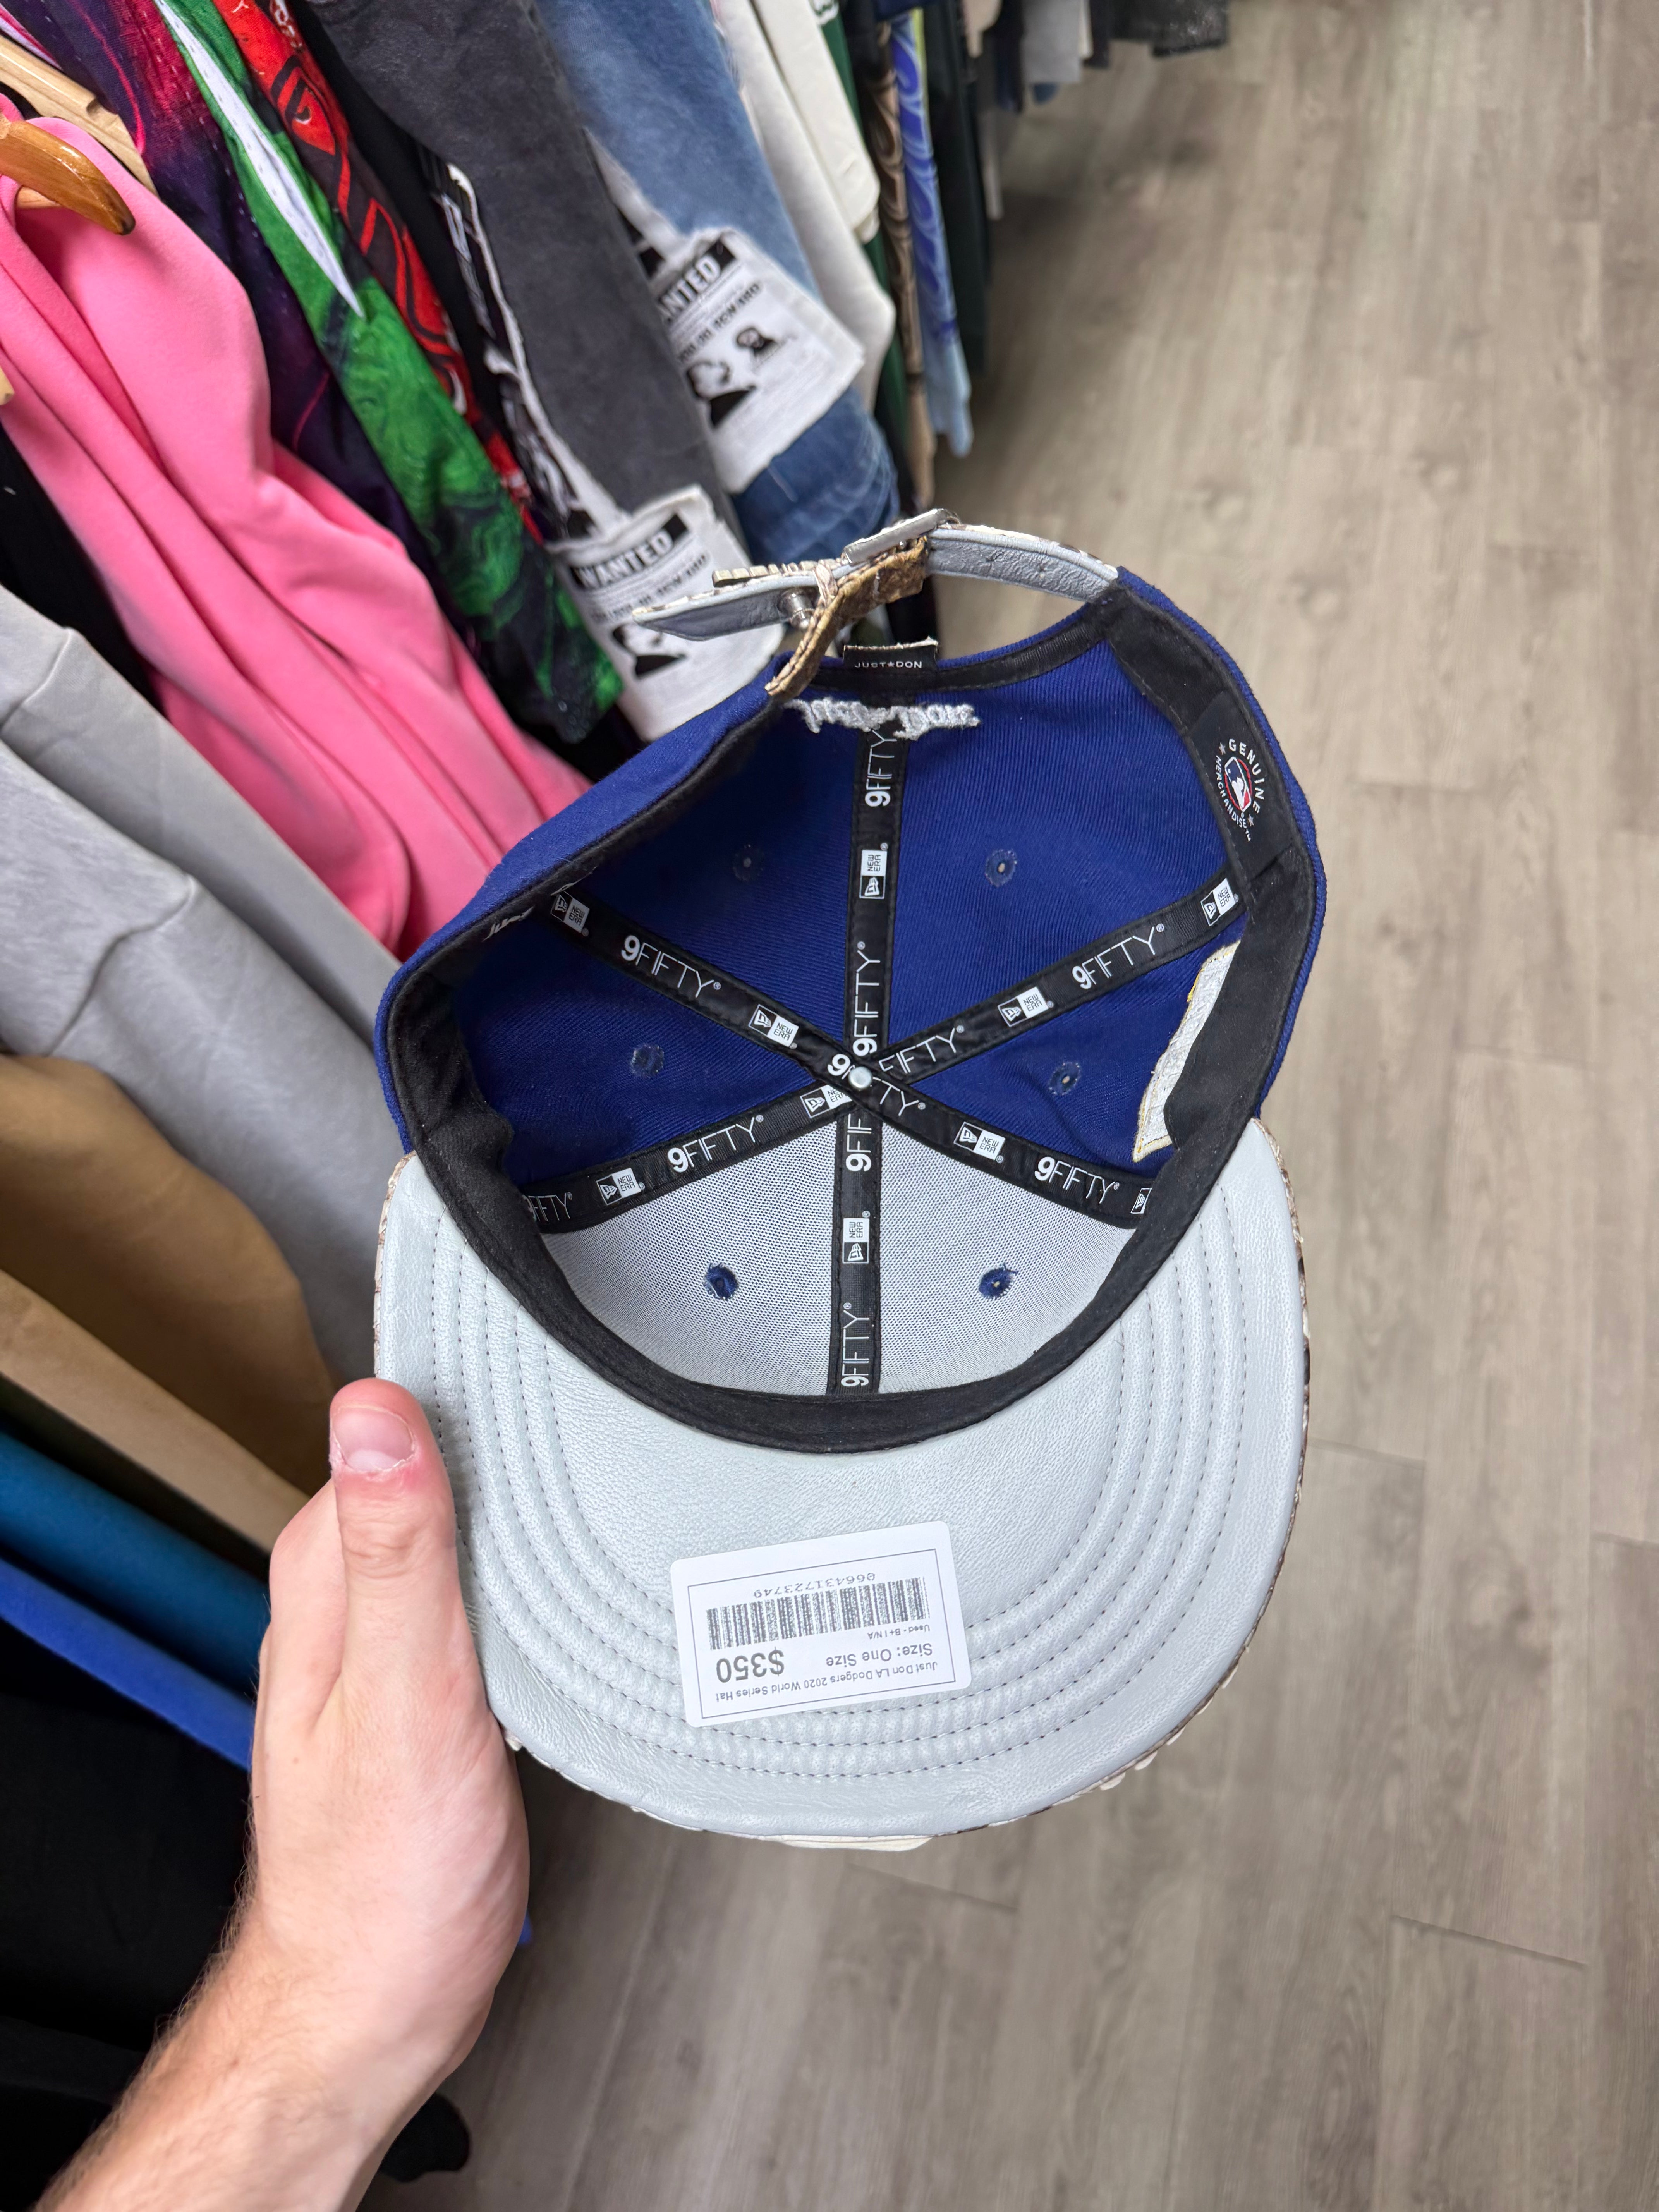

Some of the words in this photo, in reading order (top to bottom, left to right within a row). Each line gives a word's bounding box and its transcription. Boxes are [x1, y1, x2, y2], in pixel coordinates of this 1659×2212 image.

[658, 254, 721, 325] ANTED
[577, 529, 673, 589] WANTED
[1228, 738, 1265, 814] GENUINE
[1216, 755, 1247, 829] MERCHANDISE
[1218, 886, 1228, 900] NEW
[1220, 893, 1231, 907] ERA
[1023, 993, 1039, 1005] NEW
[1026, 1000, 1042, 1011] ERA
[776, 1022, 793, 1035] NEW
[774, 1029, 790, 1041] ERA
[982, 1137, 999, 1147] NEW
[979, 1143, 996, 1154] ERA
[618, 1174, 632, 1185] NEW
[620, 1181, 635, 1192] ERA
[754, 1573, 875, 1598] 066431723749
[908, 1625, 930, 1633] Used
[867, 1631, 882, 1639] N/A
[862, 1649, 891, 1661] One
[897, 1643, 932, 1656] Size:
[716, 1647, 784, 1683] $350
[826, 1654, 856, 1667] Size
[893, 1665, 913, 1674] Don
[916, 1662, 937, 1672] Just
[830, 1671, 872, 1682] Dodgers
[876, 1669, 889, 1678] LA
[772, 1682, 801, 1693] World
[804, 1678, 827, 1688] 2020
[716, 1692, 733, 1702] Hat
[736, 1686, 768, 1697] Series
